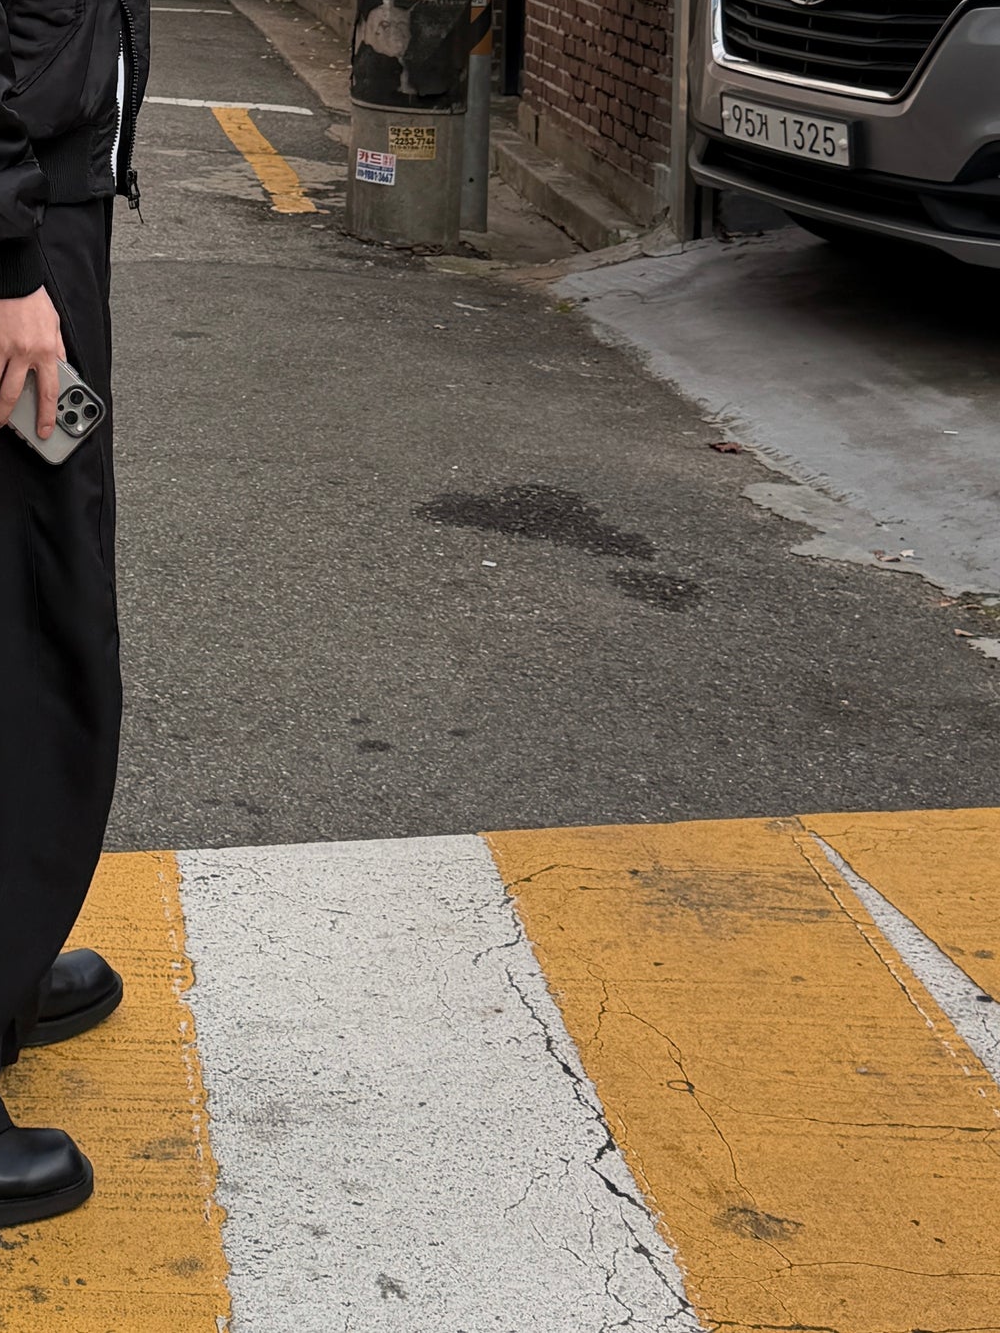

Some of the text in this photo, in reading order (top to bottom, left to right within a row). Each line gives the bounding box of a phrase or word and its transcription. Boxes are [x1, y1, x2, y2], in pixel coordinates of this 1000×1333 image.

[732, 104, 836, 157] 95거 1325
[359, 150, 382, 165] 카드
